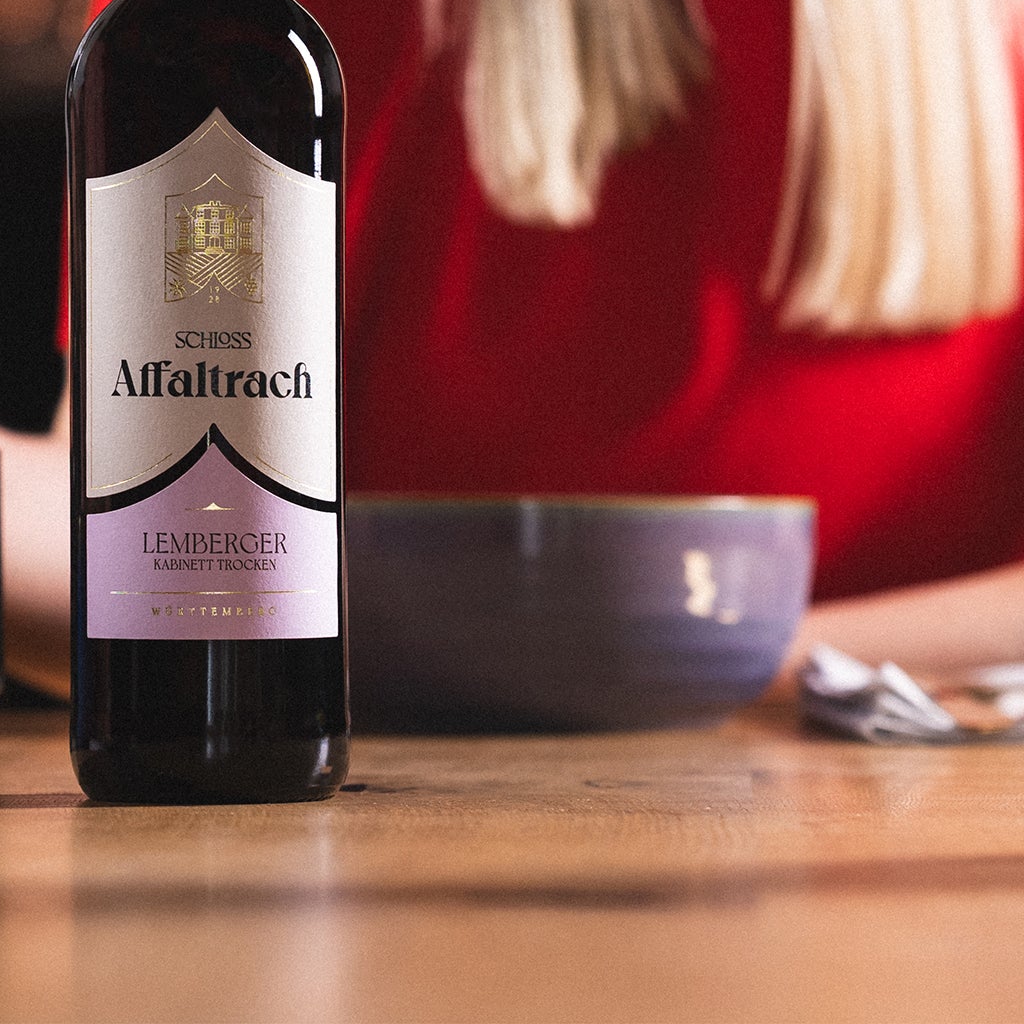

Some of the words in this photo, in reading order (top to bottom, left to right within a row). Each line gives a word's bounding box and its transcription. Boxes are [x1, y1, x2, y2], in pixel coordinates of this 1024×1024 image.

[175, 331, 252, 349] SCHLOSS
[111, 359, 313, 399] Affaltrach
[142, 532, 288, 554] LEMBERGER
[153, 558, 215, 571] KABINETT
[217, 558, 277, 571] TROCKEN
